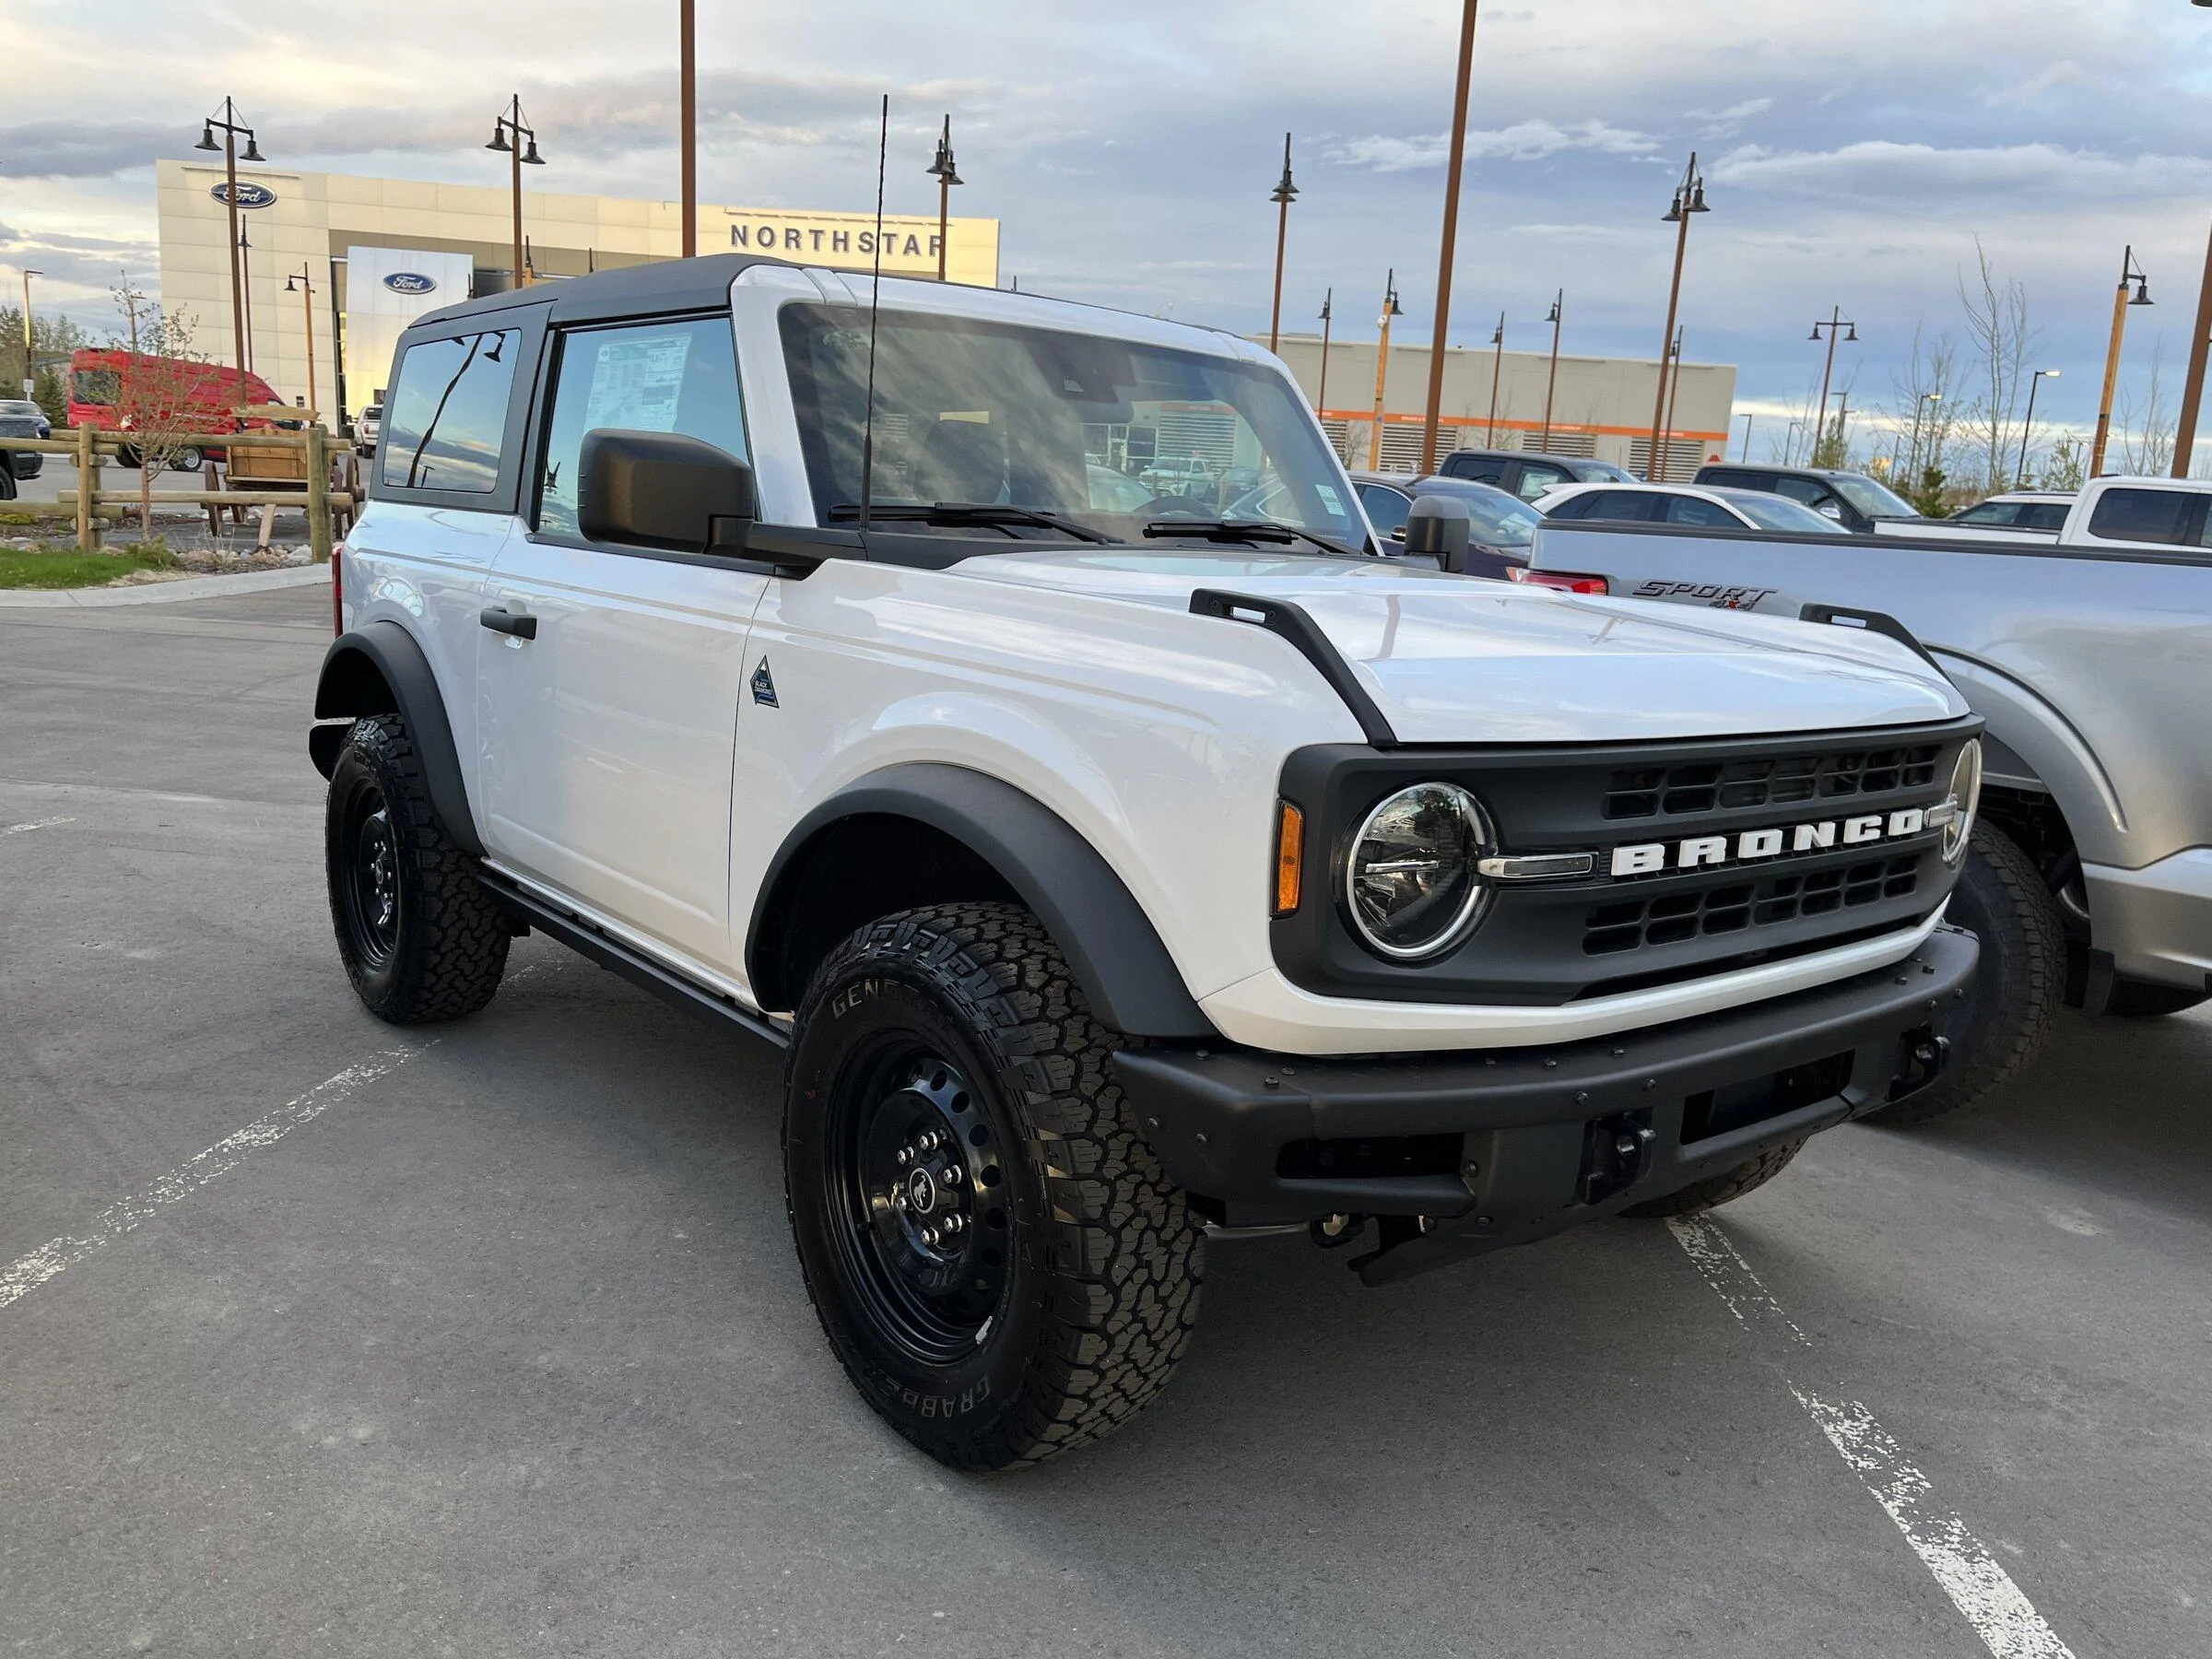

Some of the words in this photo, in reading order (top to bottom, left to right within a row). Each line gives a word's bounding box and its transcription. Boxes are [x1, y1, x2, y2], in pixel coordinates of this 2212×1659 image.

[222, 185, 261, 202] Ford
[393, 276, 424, 289] Ford
[1632, 579, 1779, 602] SPORT
[1610, 807, 1924, 877] BRONCO
